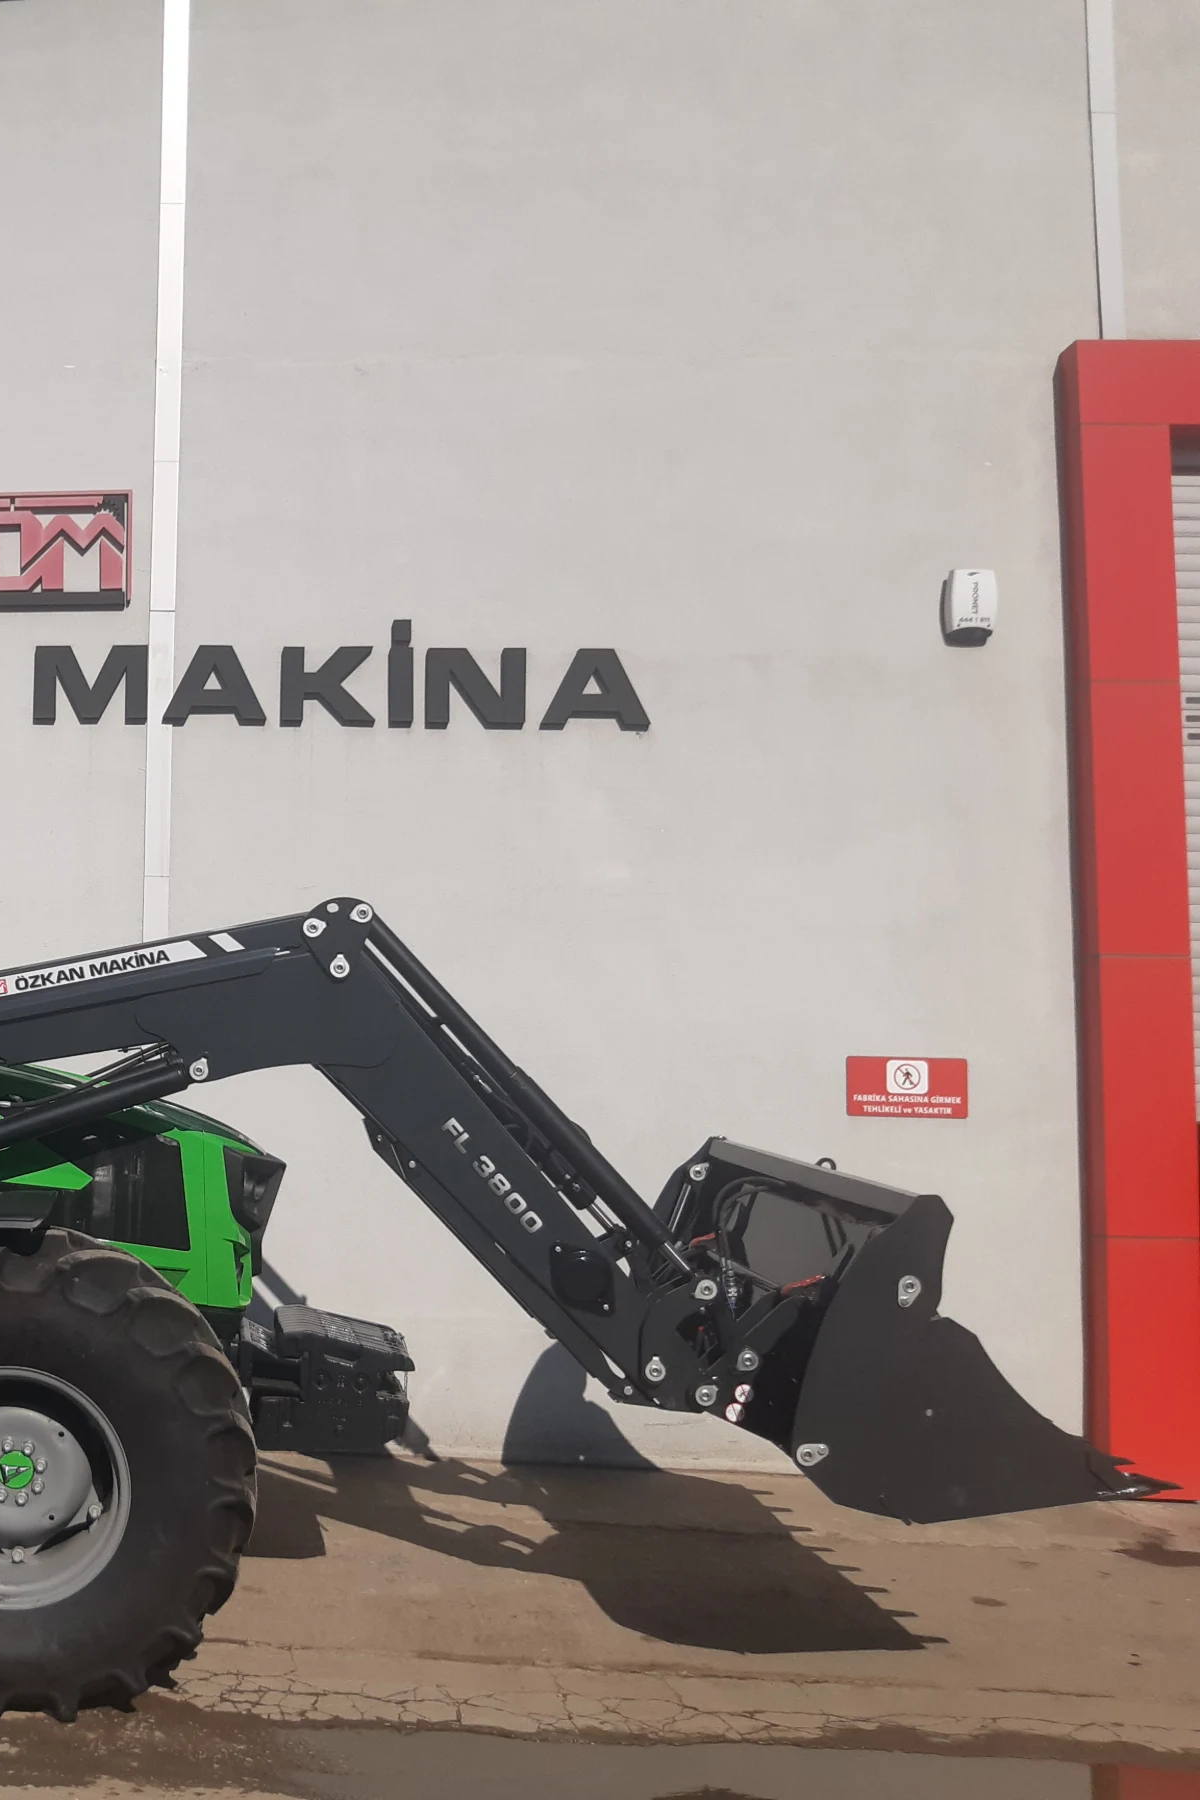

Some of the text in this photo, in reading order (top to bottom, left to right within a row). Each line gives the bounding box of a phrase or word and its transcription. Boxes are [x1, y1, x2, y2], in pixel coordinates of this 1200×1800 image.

[971, 582, 979, 615] PRONET
[32, 619, 651, 731] MAKİNA
[15, 966, 85, 991] ÖZKAN
[89, 950, 170, 977] MAKİNA
[853, 1093, 962, 1104] FABRİKA SAHASINA GİRMEK
[862, 1104, 902, 1113] TEHLİKELİ
[914, 1106, 953, 1115] YASAKTIR
[441, 1117, 543, 1234] FL 3800
